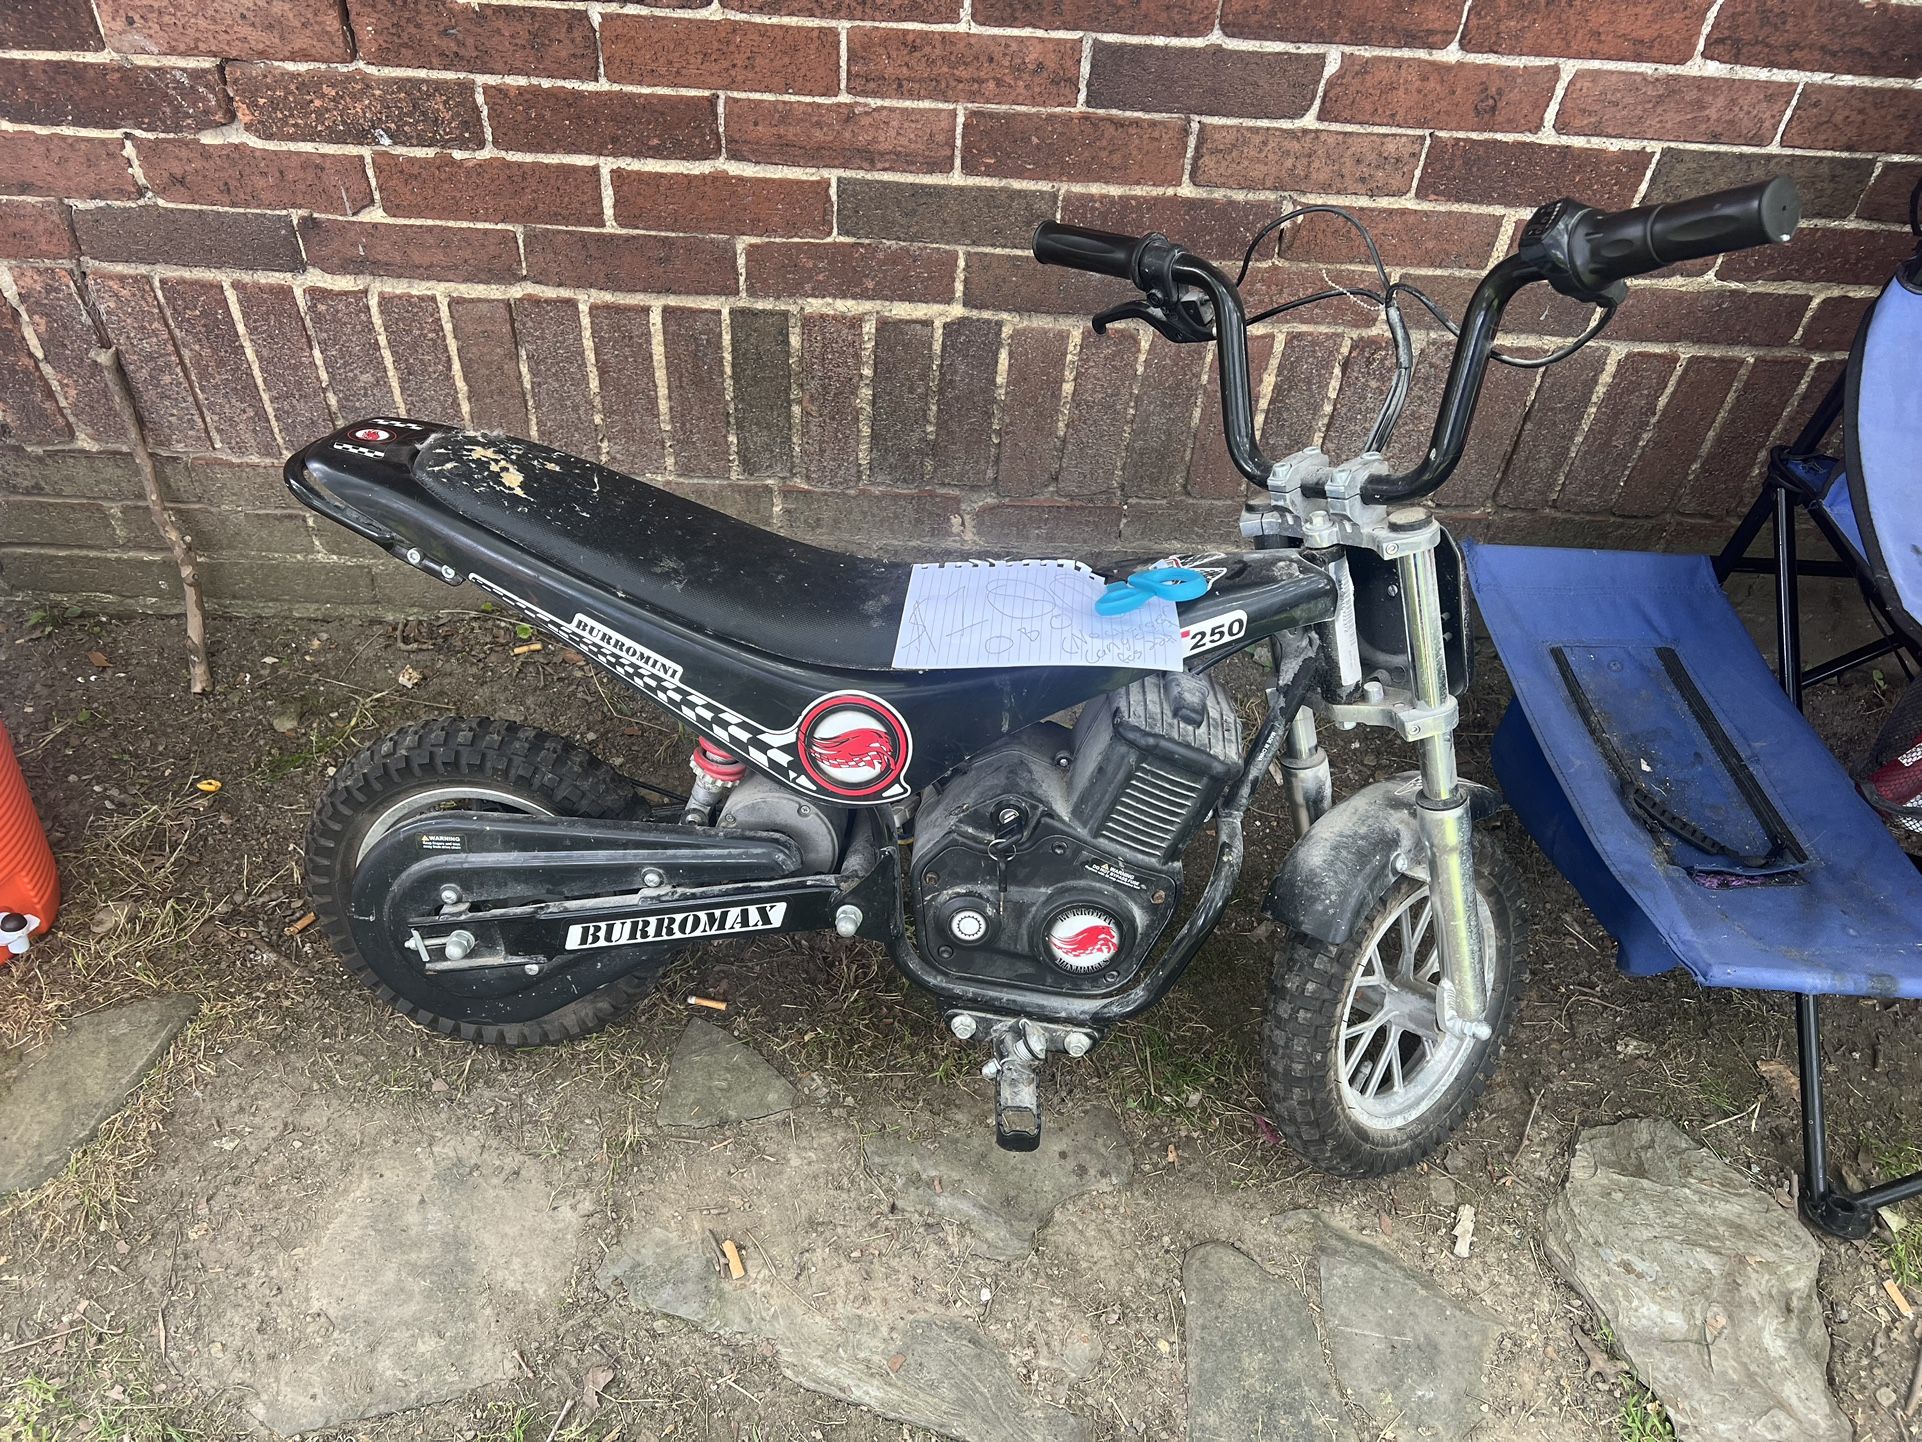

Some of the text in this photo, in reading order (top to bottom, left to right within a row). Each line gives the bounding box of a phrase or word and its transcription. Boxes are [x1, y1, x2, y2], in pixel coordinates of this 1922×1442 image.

[575, 619, 679, 679] BURROMINI
[1180, 618, 1244, 651] 250
[1110, 866, 1135, 879] WARNING
[577, 904, 777, 946] BURROMAX
